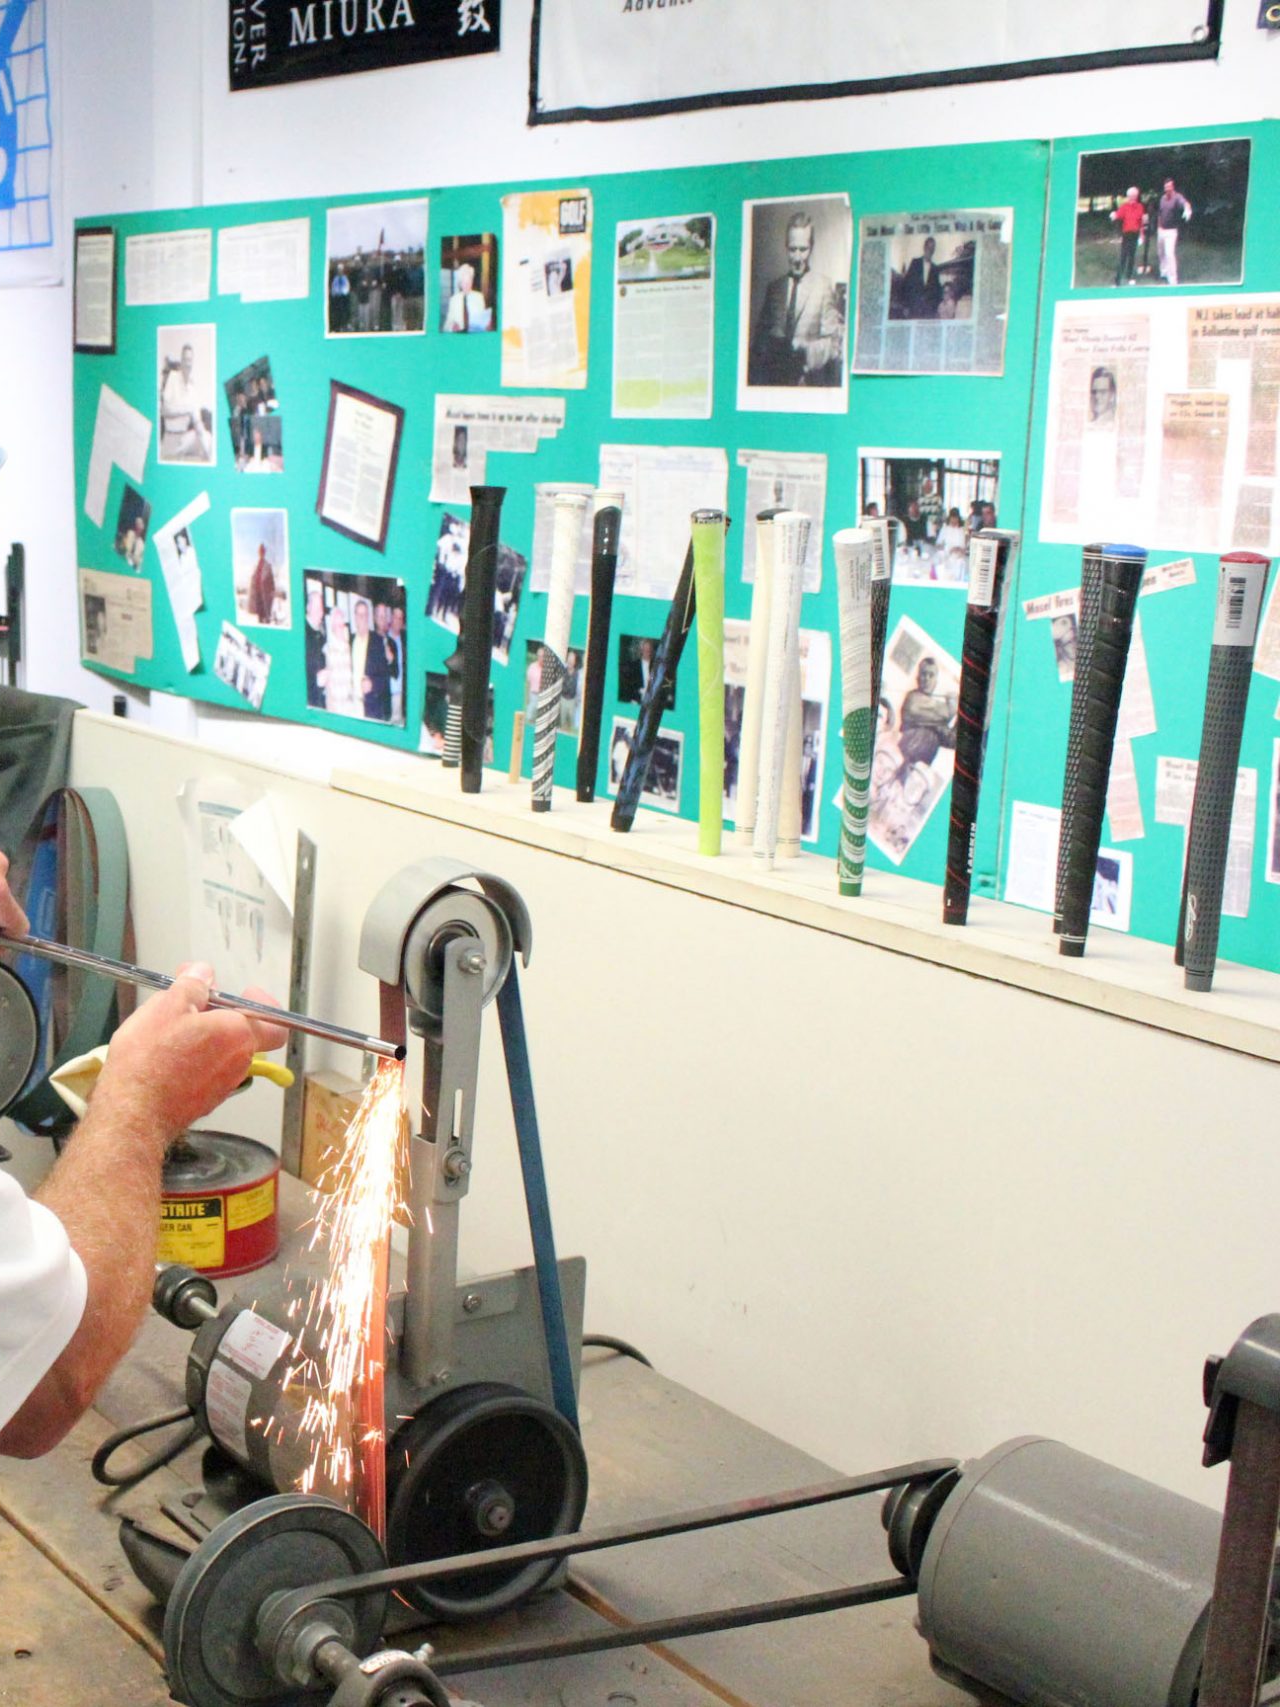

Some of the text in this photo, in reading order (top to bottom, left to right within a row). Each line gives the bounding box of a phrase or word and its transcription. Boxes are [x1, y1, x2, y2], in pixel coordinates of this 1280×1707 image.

[289, 0, 416, 47] MIURA
[1235, 308, 1252, 319] lead
[1243, 324, 1258, 338] golf
[160, 1204, 205, 1216] STRITE
